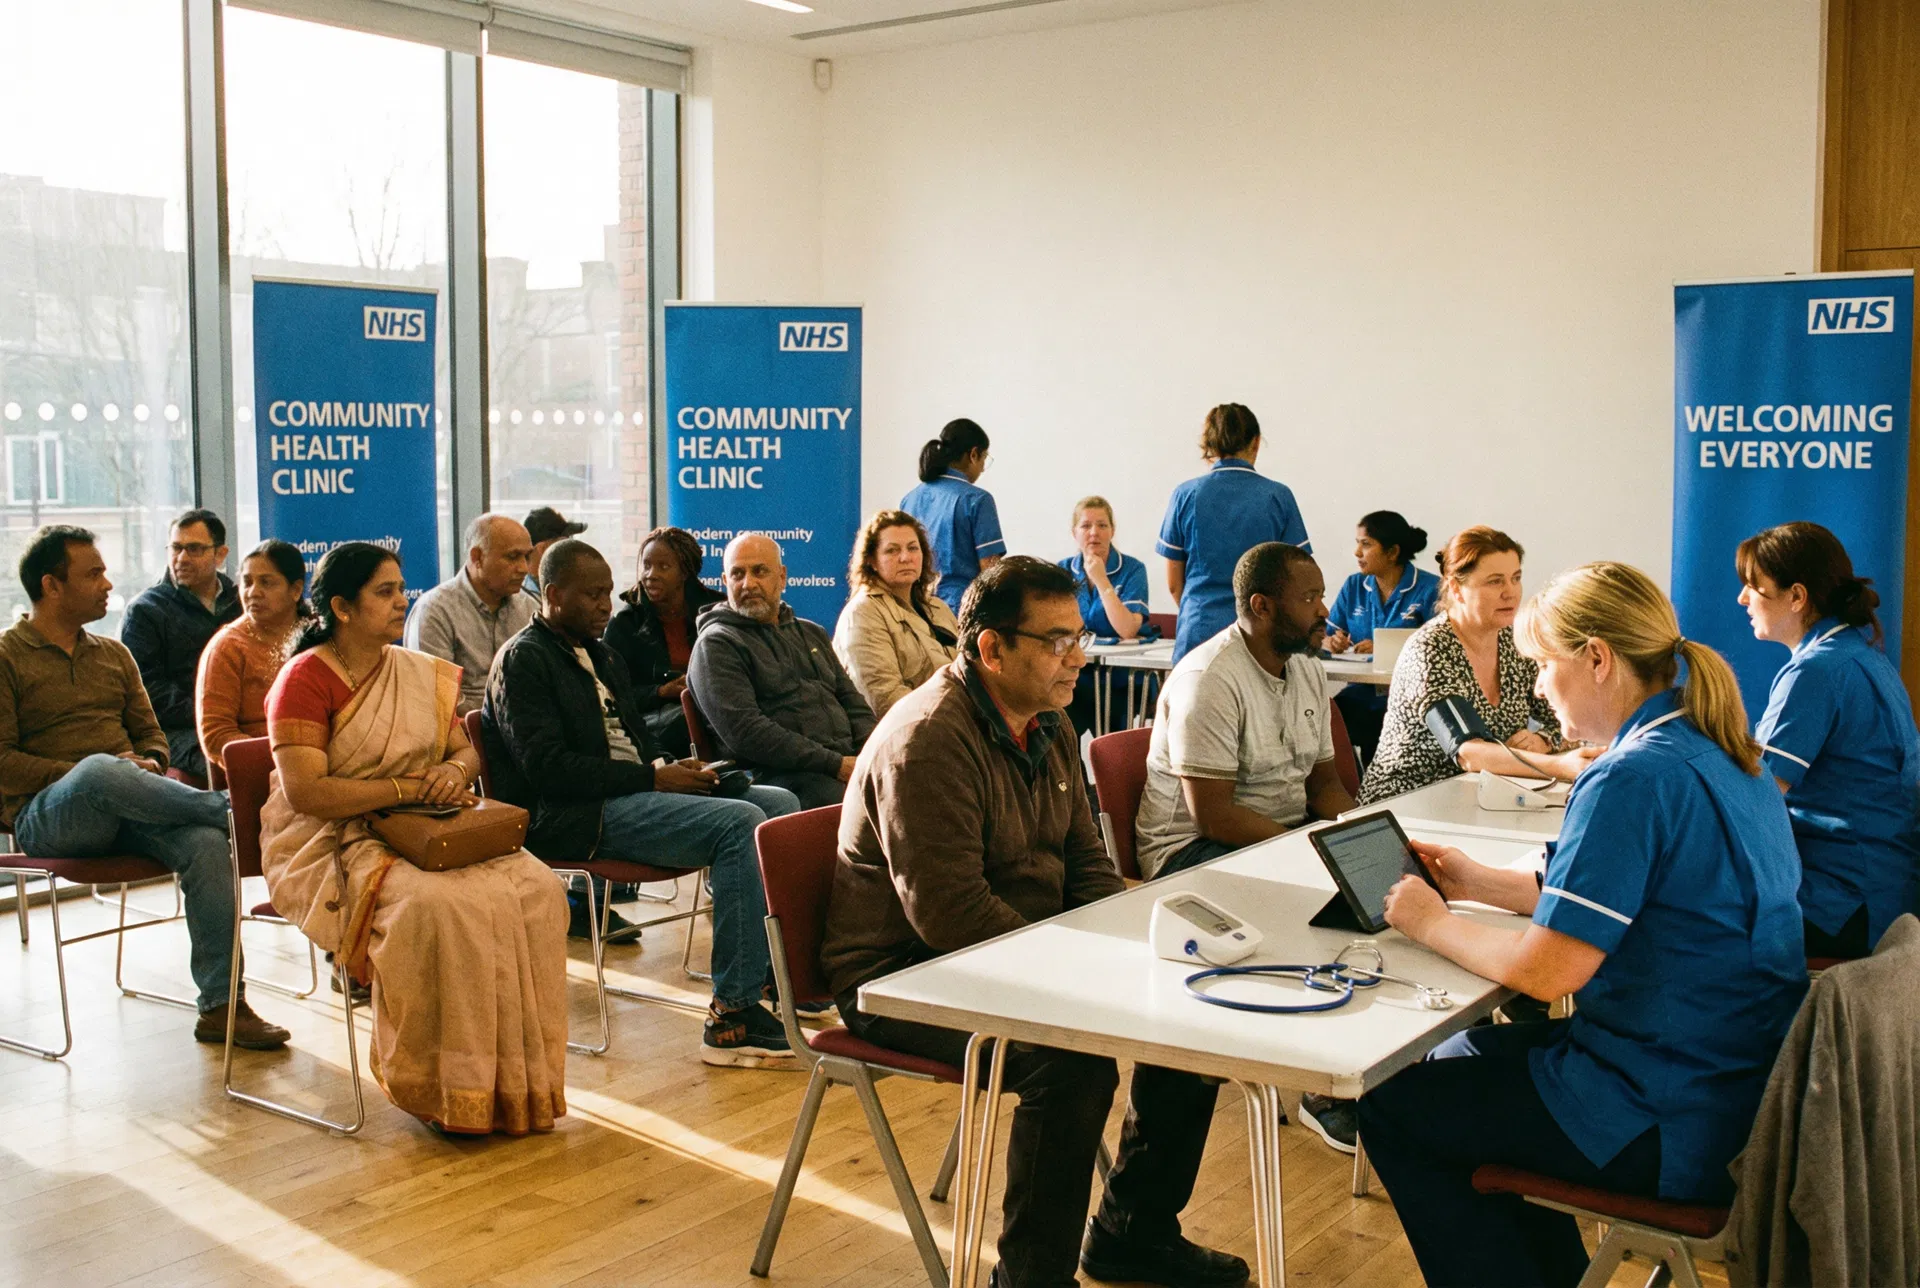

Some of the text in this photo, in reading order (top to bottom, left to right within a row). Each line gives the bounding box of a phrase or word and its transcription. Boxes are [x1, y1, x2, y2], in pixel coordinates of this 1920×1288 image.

[368, 310, 422, 337] NHS
[1811, 300, 1890, 330] NHS
[783, 325, 844, 348] NHS
[268, 400, 431, 428] COMMUNITY
[677, 406, 852, 430] COMMUNITY
[1684, 404, 1893, 432] WELCOMING
[270, 435, 370, 461] HEALTH
[678, 436, 781, 460] HEALTH
[1700, 440, 1873, 469] EVERYONE
[271, 468, 354, 495] CLINIC
[678, 466, 763, 489] CLINIC
[288, 535, 402, 554] dern cunity
